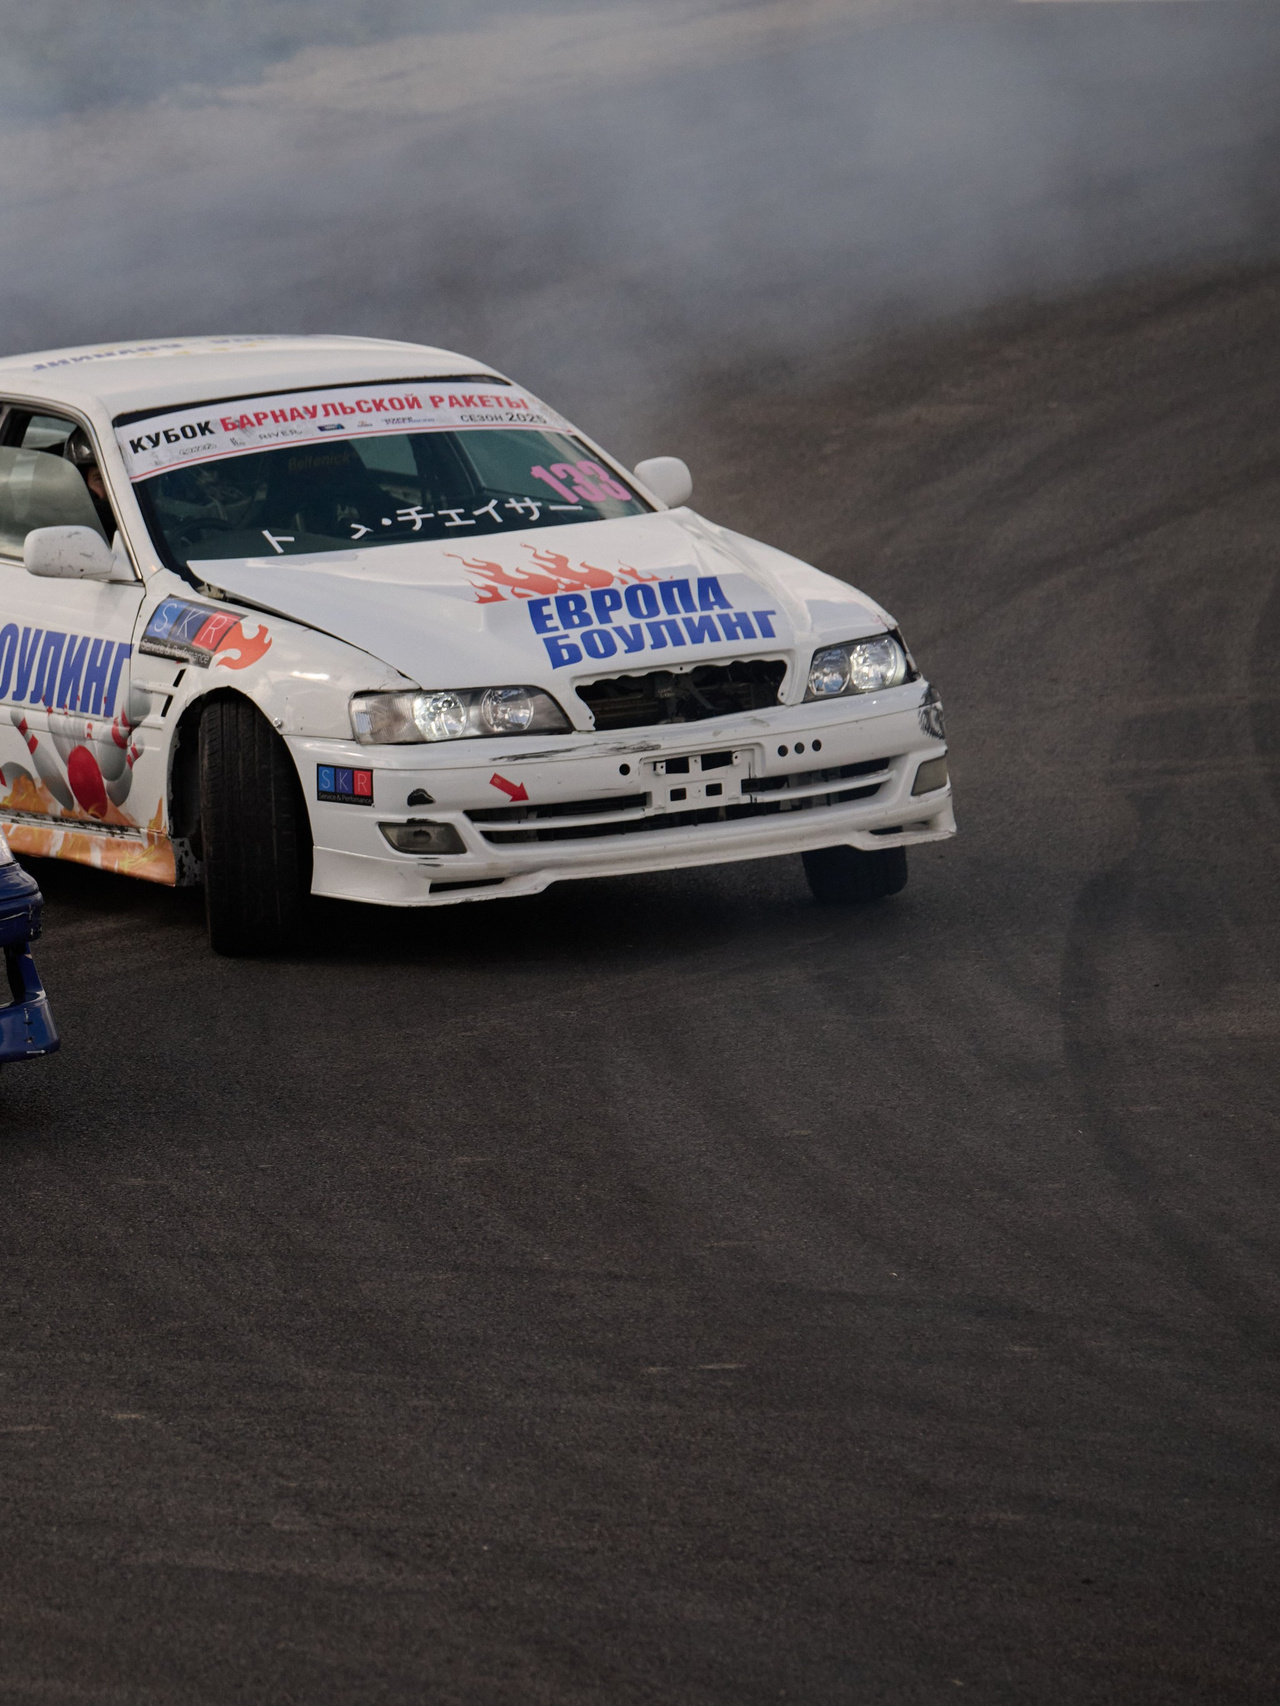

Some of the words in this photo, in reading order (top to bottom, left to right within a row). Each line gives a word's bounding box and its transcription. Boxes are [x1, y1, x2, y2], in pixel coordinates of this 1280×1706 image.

[129, 420, 216, 454] КУБОК
[220, 393, 422, 432] БАРНАУЛЬСКОЙ
[429, 394, 530, 410] РАКЕТЫ
[460, 414, 503, 423] СЕЗОН
[506, 412, 547, 424] 2025
[530, 460, 632, 504] 133
[153, 602, 228, 644] SKR
[527, 576, 735, 635] ЕВРОПА
[542, 610, 777, 670] БОУЛИНГ
[322, 769, 368, 793] SKR
